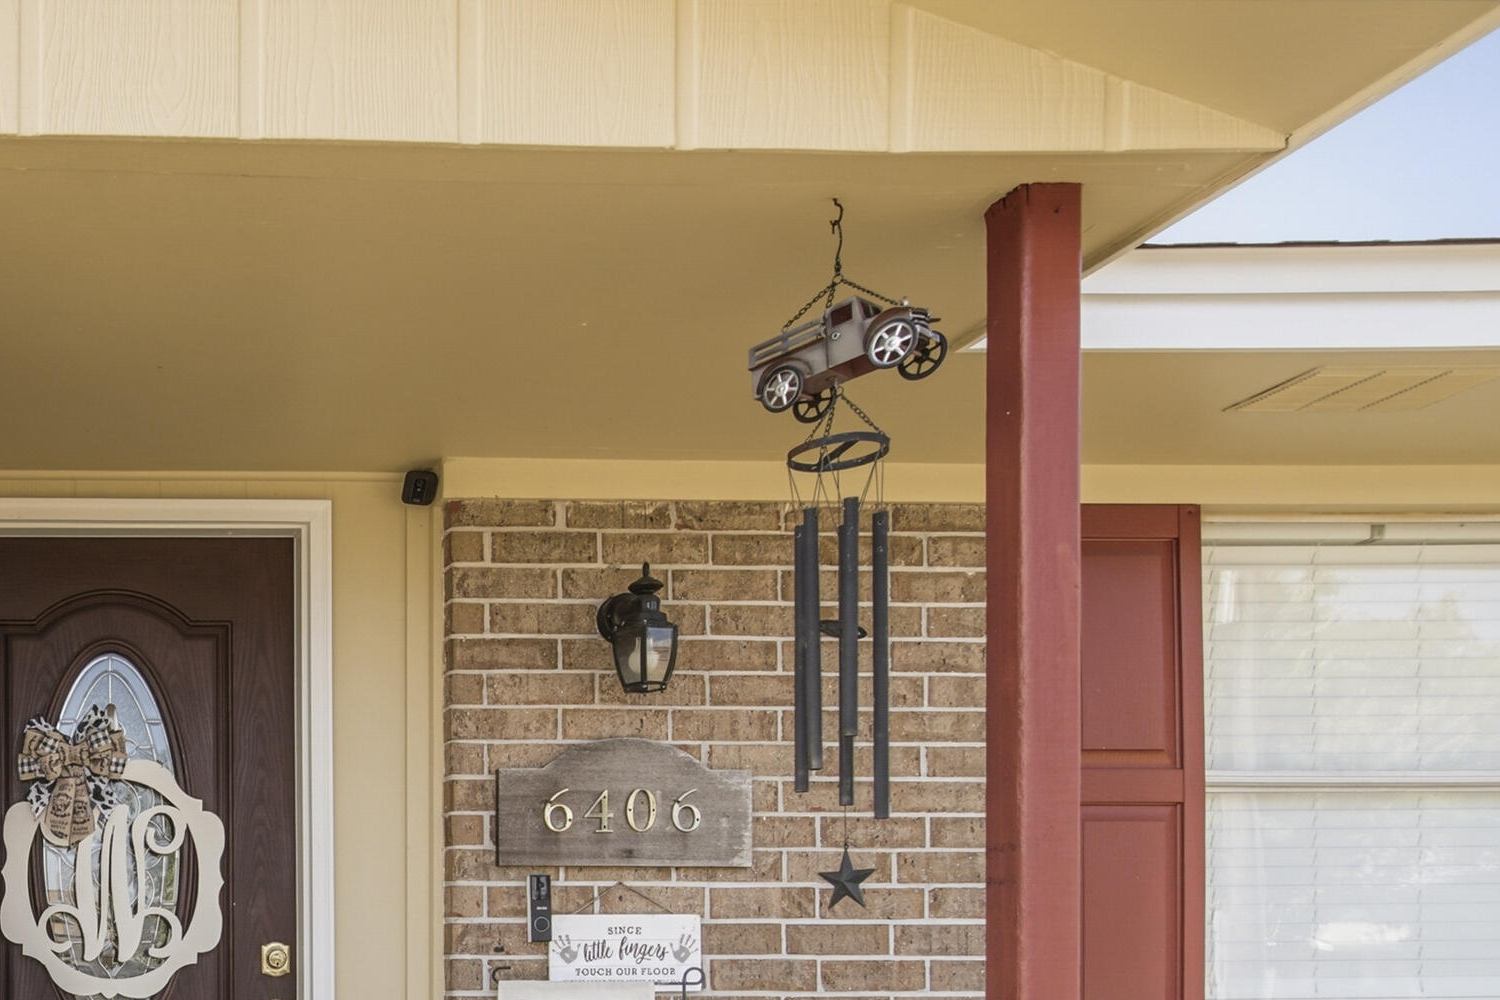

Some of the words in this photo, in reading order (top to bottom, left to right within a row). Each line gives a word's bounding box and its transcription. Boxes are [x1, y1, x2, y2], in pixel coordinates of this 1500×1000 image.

[543, 788, 702, 833] 6406
[607, 926, 643, 936] SINCE
[582, 938, 614, 963] little
[618, 935, 669, 965] fingers
[574, 967, 612, 977] TOUCH
[615, 967, 638, 976] OUR
[640, 967, 677, 976] FLOOR
